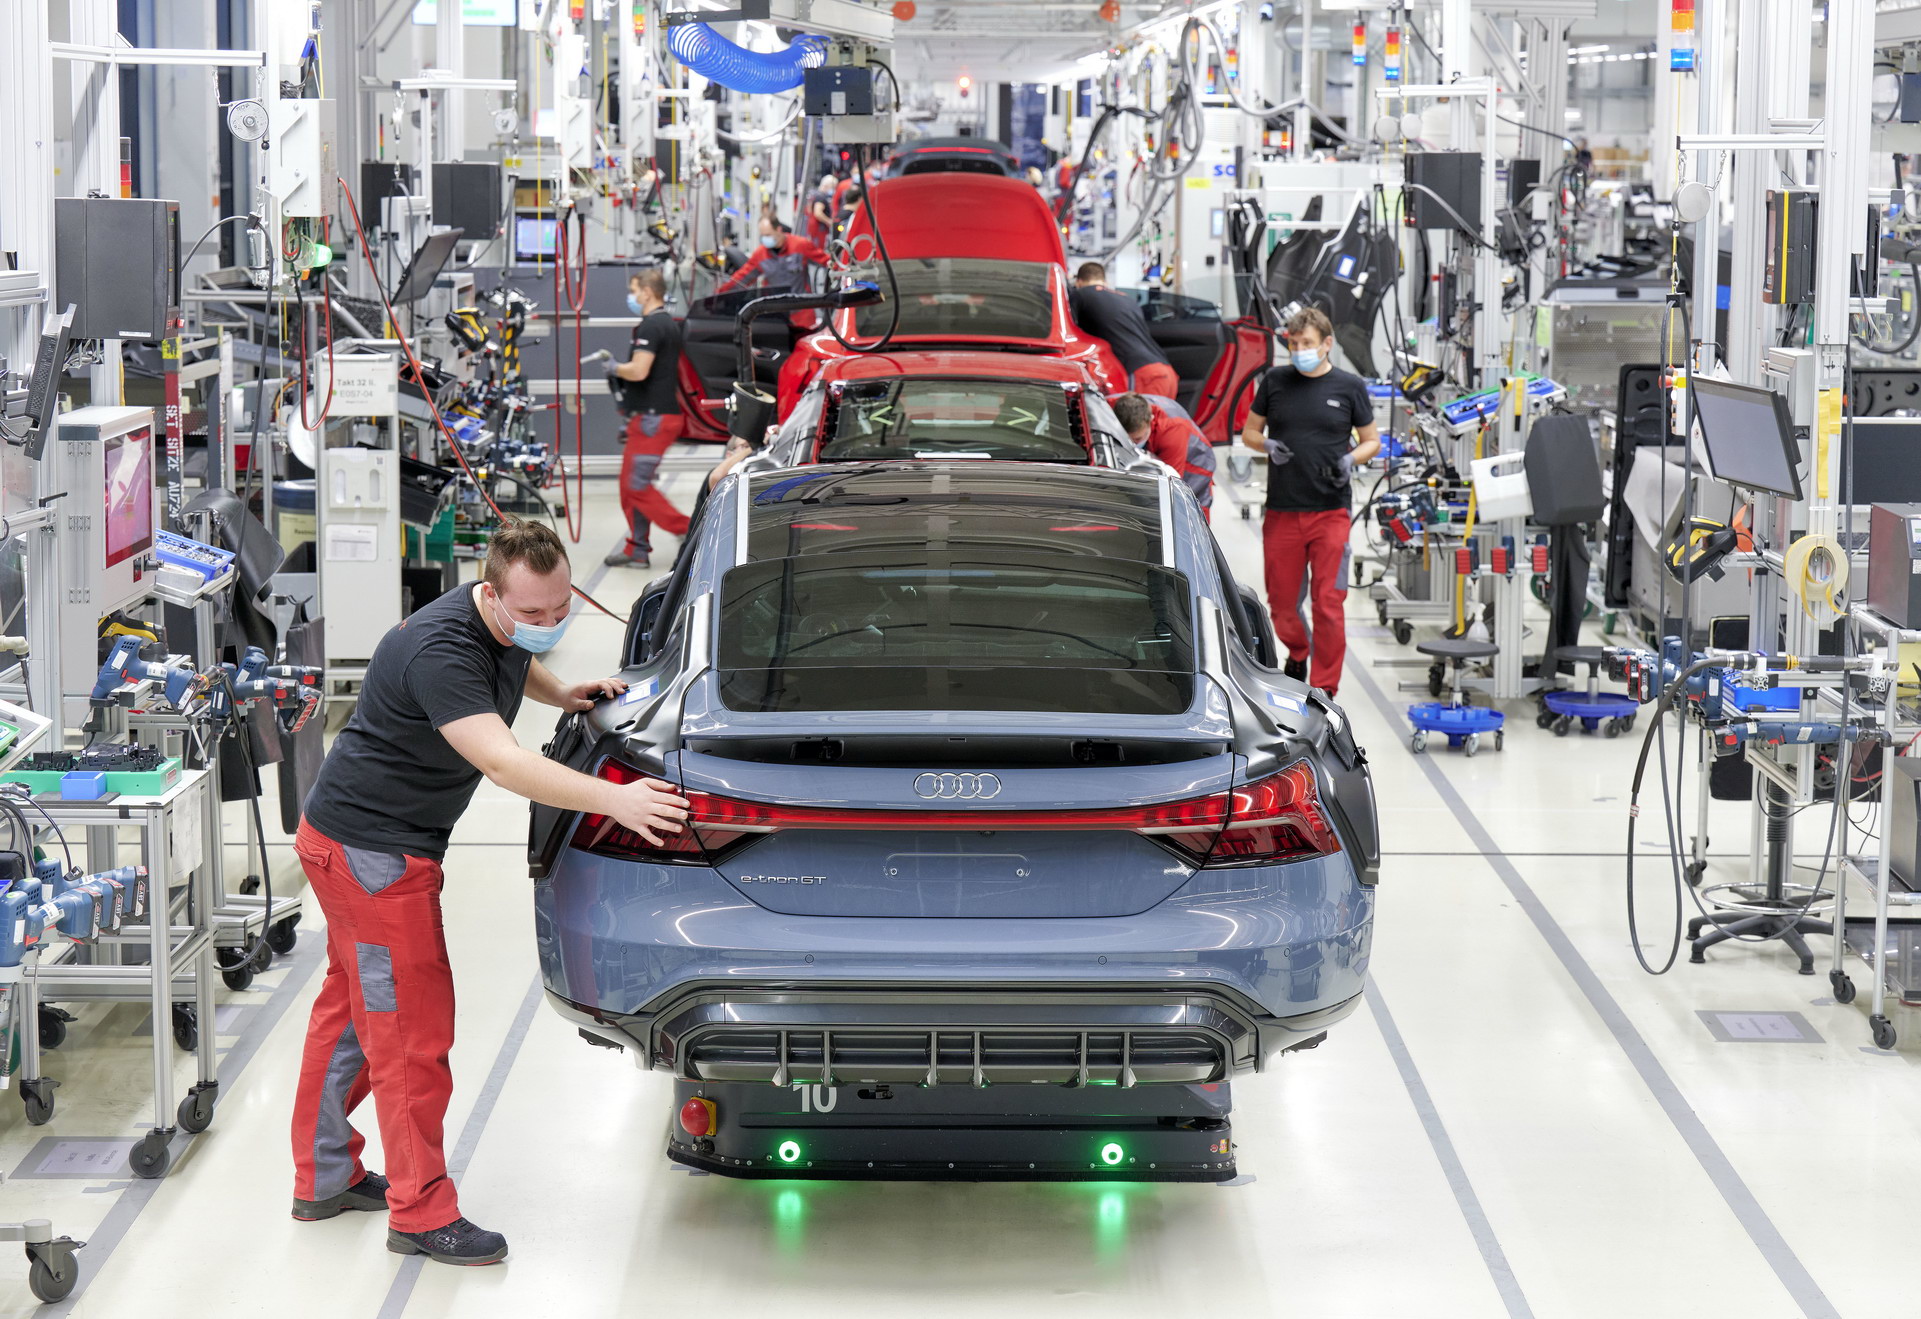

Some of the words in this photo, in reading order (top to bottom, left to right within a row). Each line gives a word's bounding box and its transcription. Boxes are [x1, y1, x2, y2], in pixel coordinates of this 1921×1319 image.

[166, 404, 178, 428] SET
[167, 437, 180, 472] SITZE
[168, 481, 182, 518] AU724
[740, 874, 799, 884] e-tron
[801, 875, 827, 885] GT
[792, 1083, 838, 1113] 10
